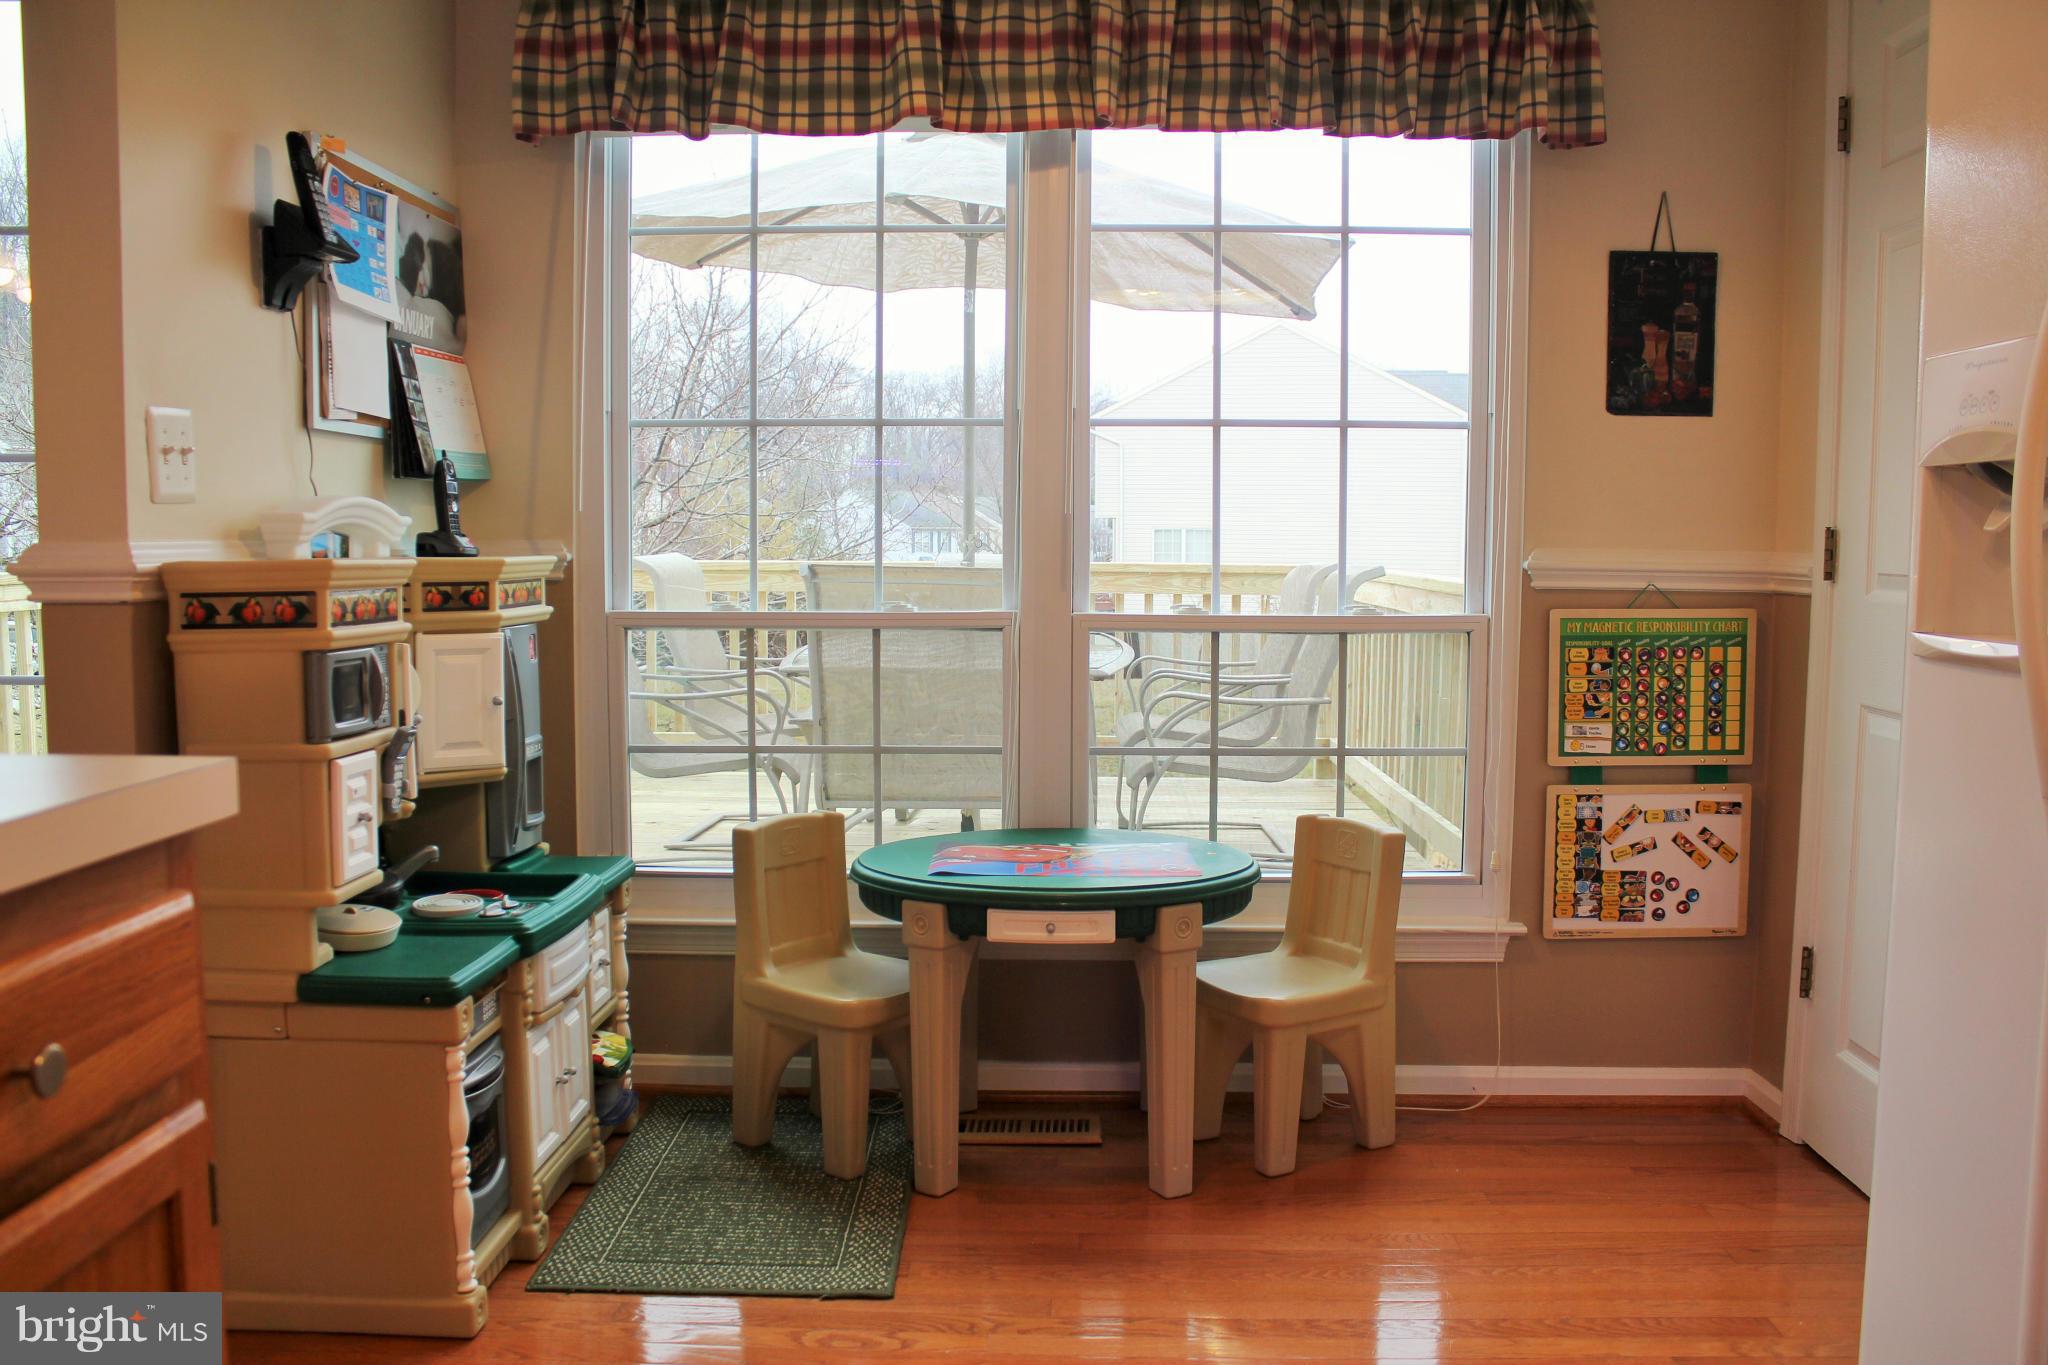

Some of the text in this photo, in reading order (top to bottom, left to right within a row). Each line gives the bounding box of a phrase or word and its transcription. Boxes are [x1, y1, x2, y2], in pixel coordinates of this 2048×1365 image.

[1567, 621, 1744, 633] MY MAGNETIC RESPONSIBILITY CHART
